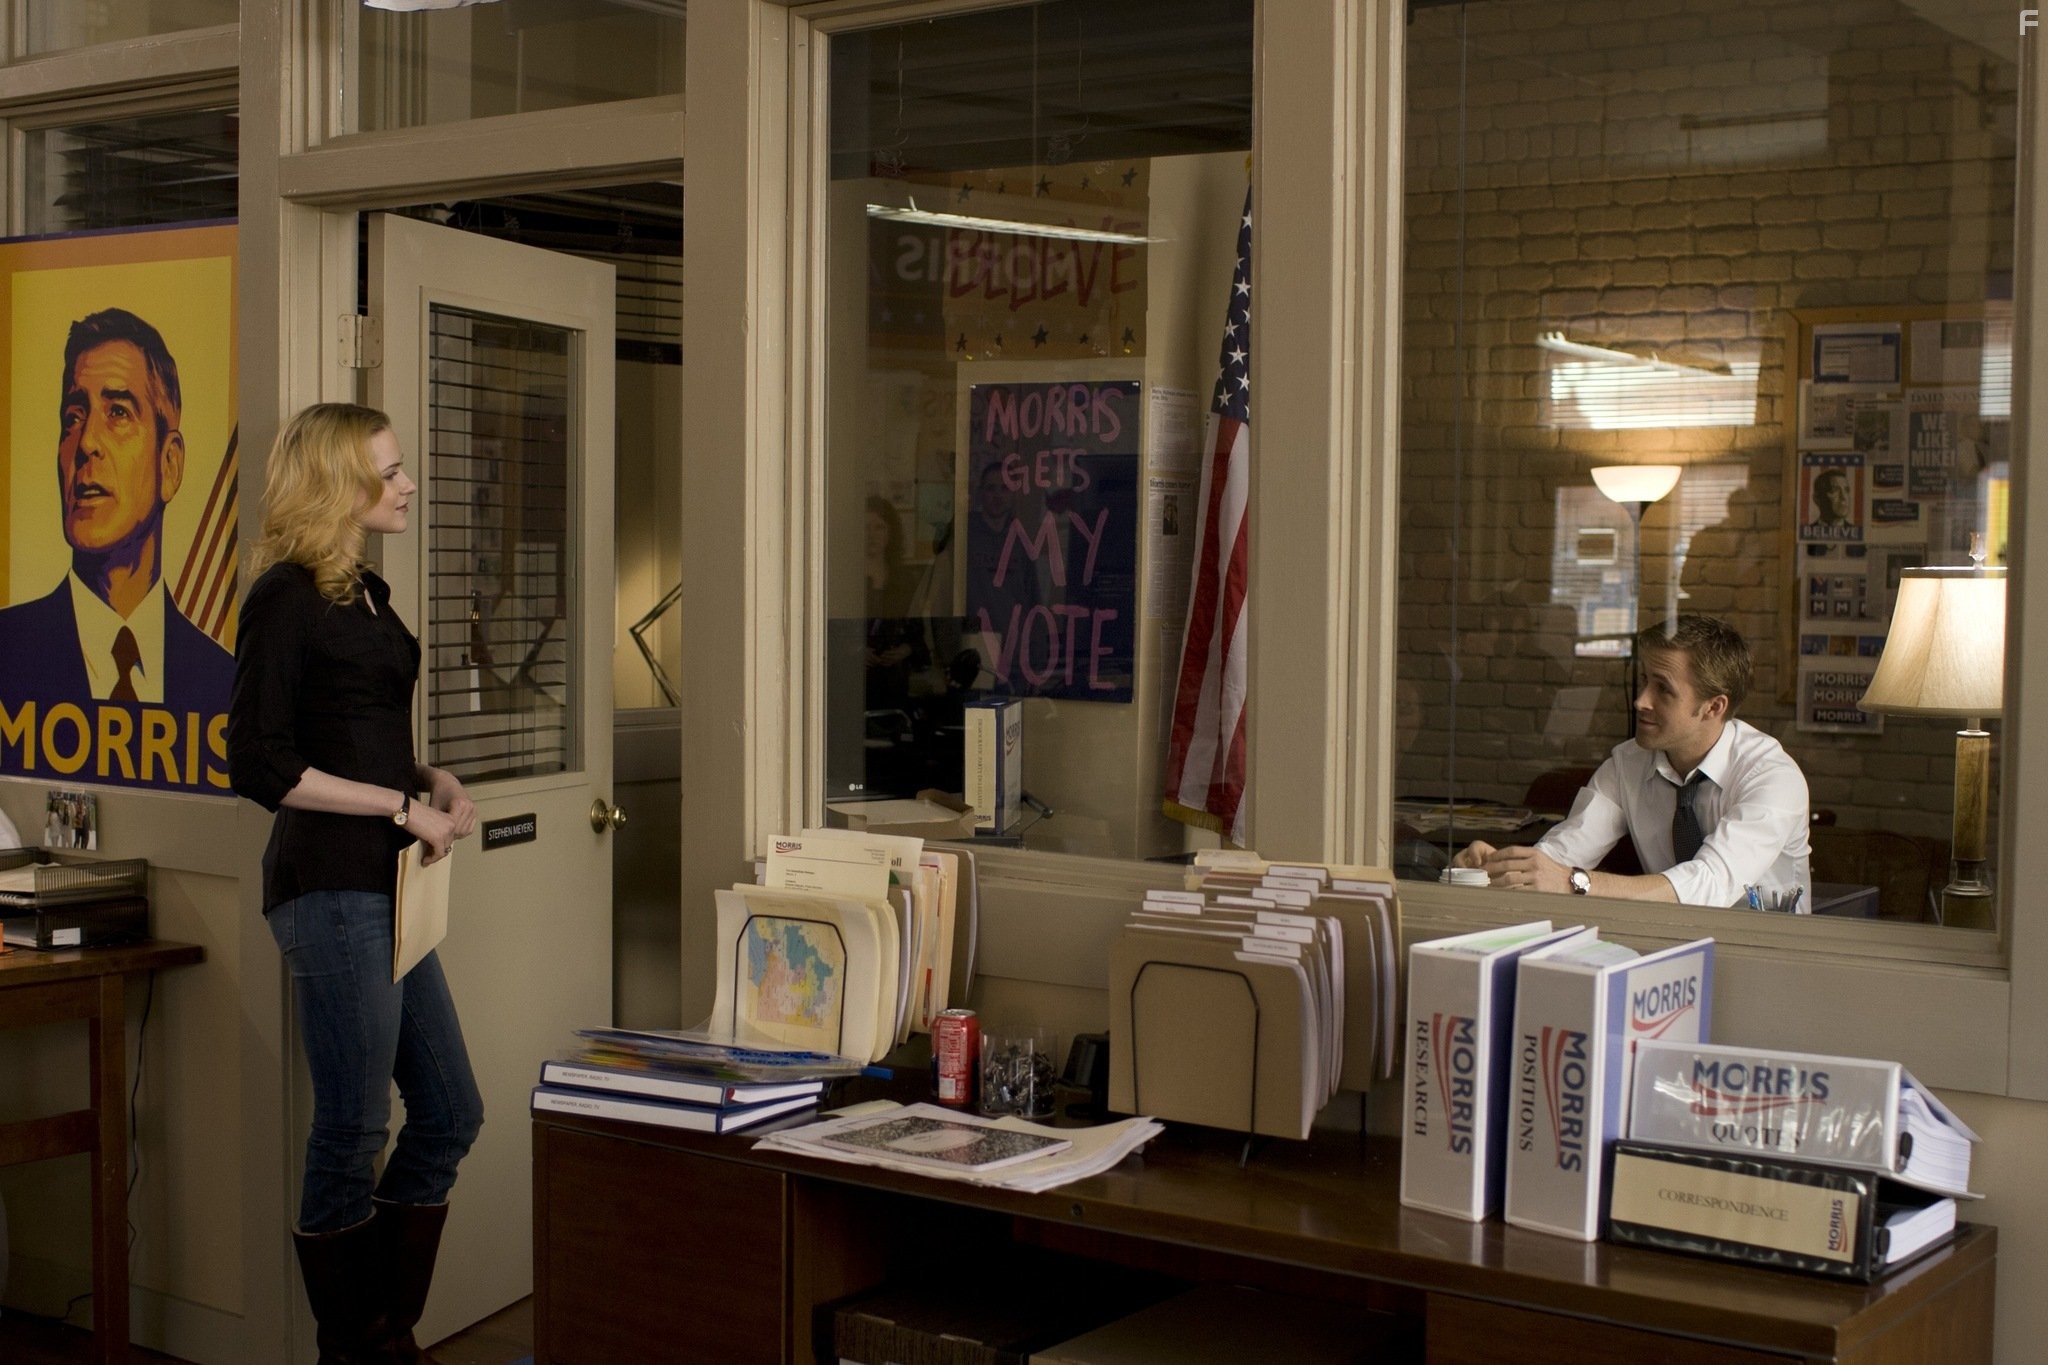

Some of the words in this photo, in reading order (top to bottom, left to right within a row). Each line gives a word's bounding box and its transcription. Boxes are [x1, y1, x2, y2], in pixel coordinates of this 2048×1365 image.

[985, 384, 1124, 444] MORRIS
[1921, 412, 1946, 431] WE
[1918, 431, 1948, 449] LIKE
[1000, 447, 1091, 495] GETS
[993, 506, 1109, 588] MY
[1803, 525, 1858, 539] BELIEVE
[977, 602, 1119, 689] VOTE
[1814, 673, 1867, 686] MORRIS
[1817, 710, 1863, 723] MORRIS
[0, 699, 231, 788] MORRIS
[488, 826, 512, 840] STEPHEN
[513, 821, 534, 835] MEYERS
[776, 841, 802, 849] MORRIS
[1632, 976, 1697, 1020] MORRIS
[1415, 1020, 1428, 1136] RESEARCH
[1451, 1016, 1475, 1155] MORRIS
[1519, 1034, 1537, 1152] POSITIONS
[1692, 1059, 1830, 1099] MORRIS
[1559, 1032, 1587, 1173] MORRIS
[1711, 1122, 1803, 1149] QUOTES
[1658, 1188, 1789, 1222] CORRESPONDENCE
[1827, 1199, 1844, 1252] MORRIS
